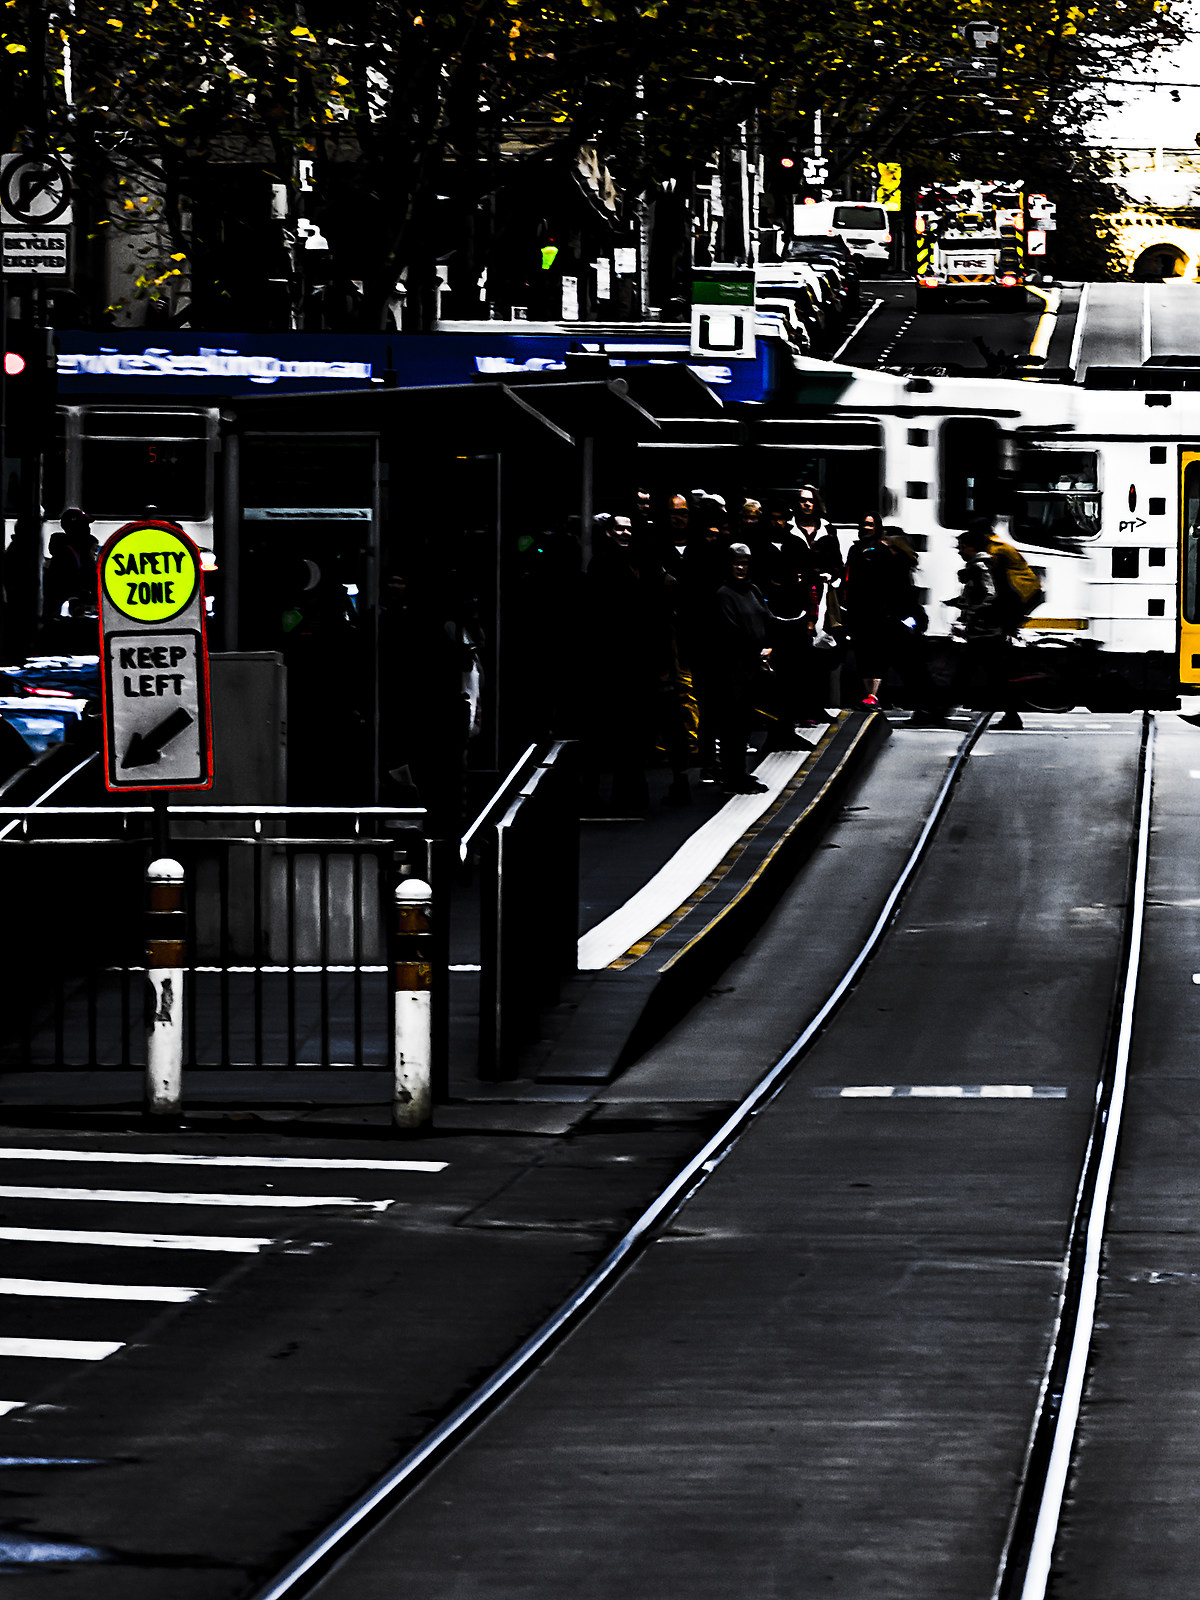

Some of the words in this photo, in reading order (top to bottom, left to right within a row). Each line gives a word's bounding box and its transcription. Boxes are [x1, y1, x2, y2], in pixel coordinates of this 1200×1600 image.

[111, 551, 187, 577] SAFETY
[126, 581, 176, 605] ZONE
[119, 646, 187, 670] KEEP
[123, 674, 186, 698] LEFT
